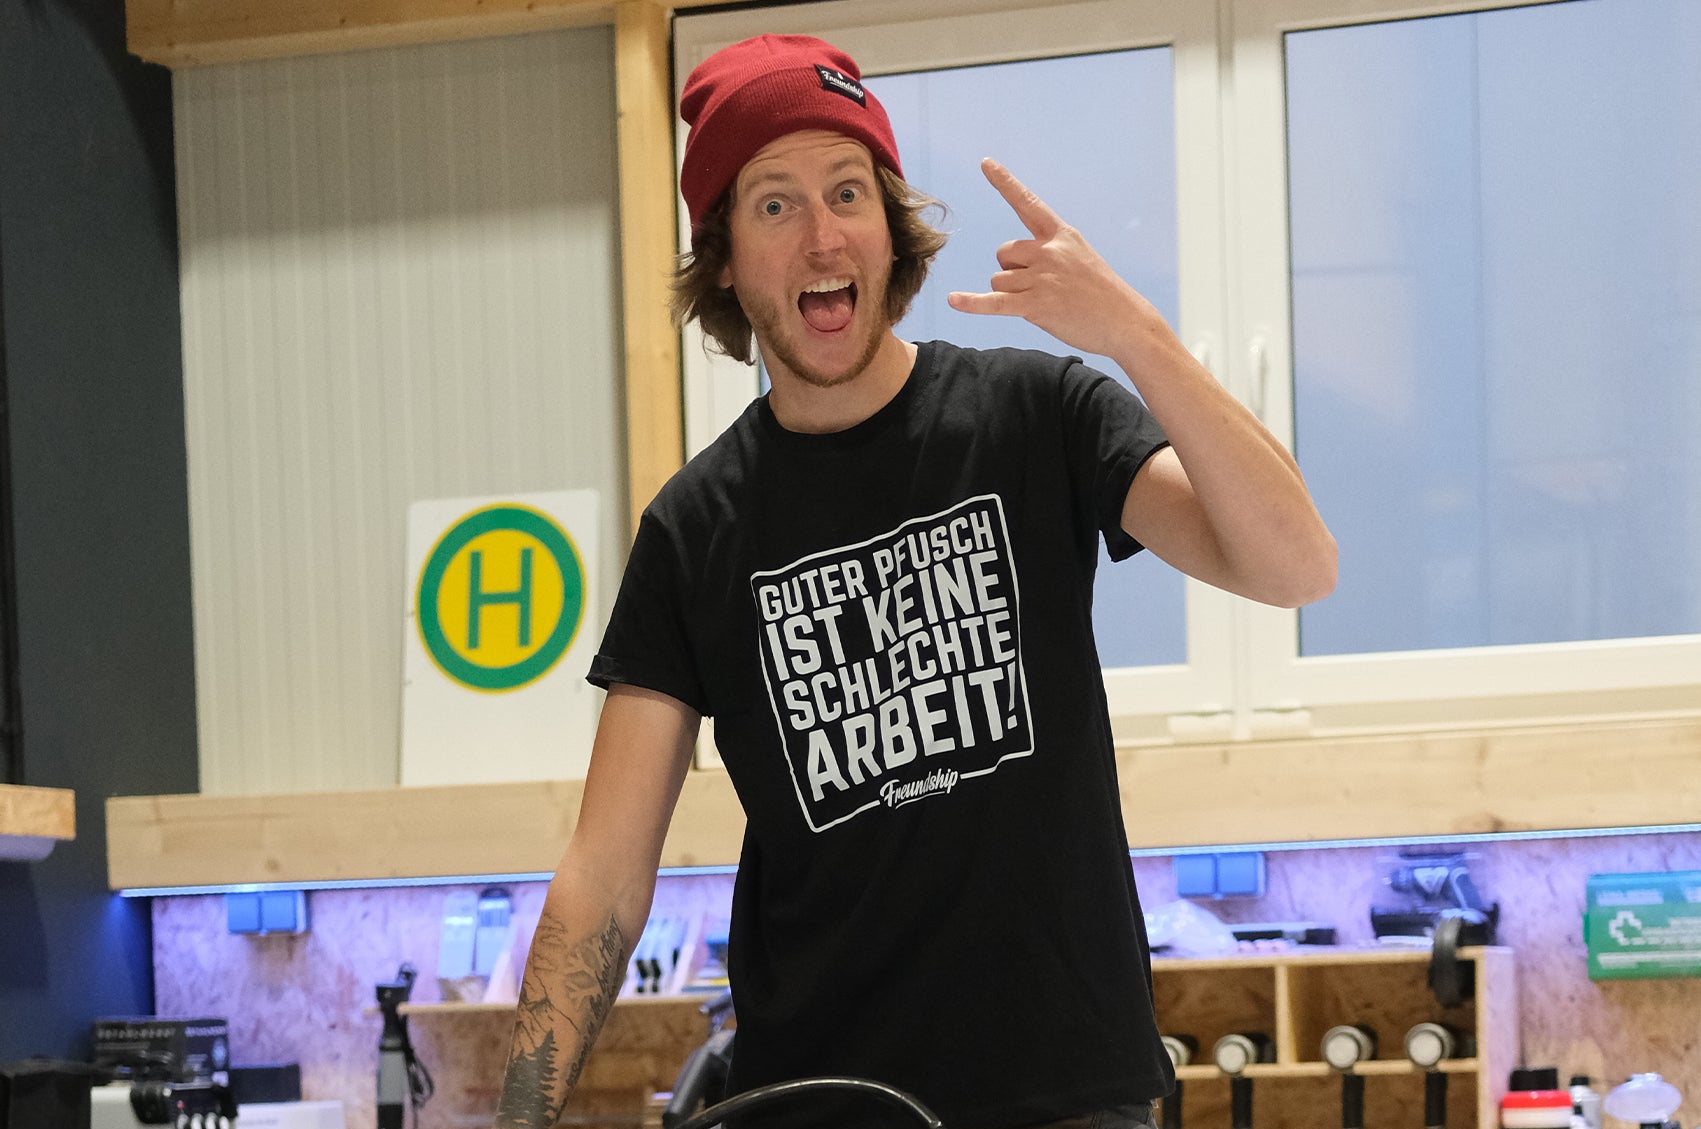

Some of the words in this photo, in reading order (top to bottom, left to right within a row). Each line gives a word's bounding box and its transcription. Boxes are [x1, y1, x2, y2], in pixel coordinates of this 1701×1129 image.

[821, 70, 864, 98] Freundship
[467, 547, 533, 650] H
[758, 560, 868, 622] GUTER
[872, 510, 996, 588] PFUSCH
[766, 604, 847, 682] IST
[863, 549, 1008, 653] KEINE
[782, 611, 1016, 731] SCHLECHTE
[807, 661, 1018, 802] ARBEIT!
[879, 768, 959, 808] Freundship
